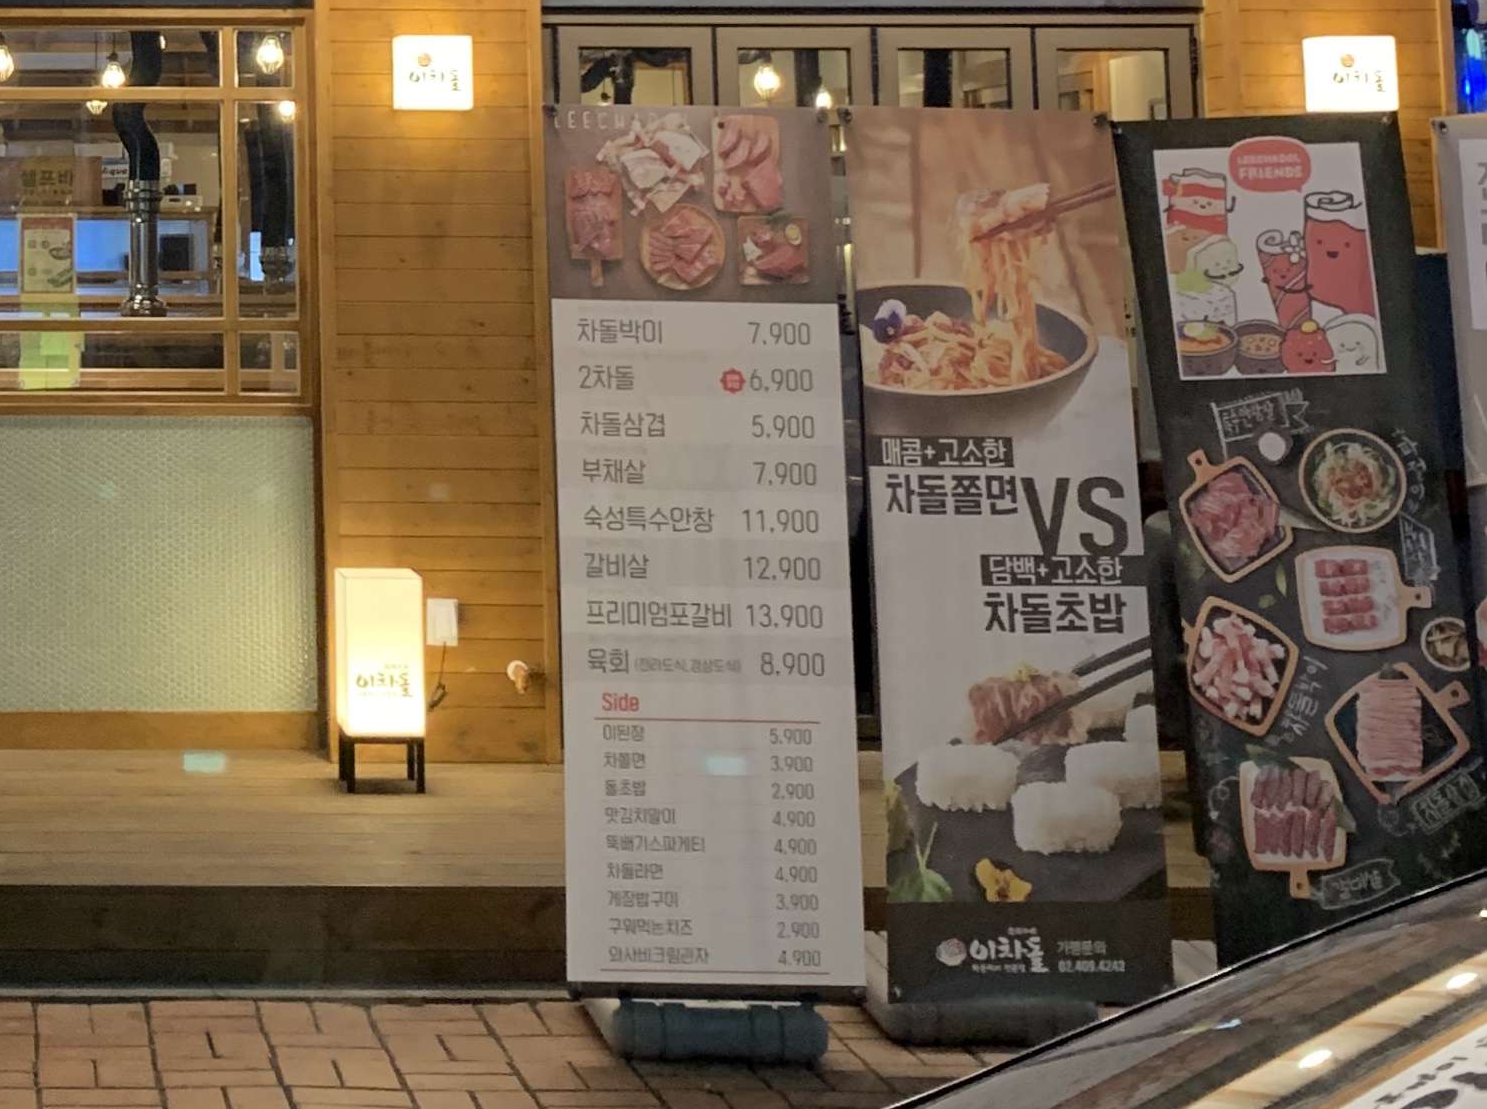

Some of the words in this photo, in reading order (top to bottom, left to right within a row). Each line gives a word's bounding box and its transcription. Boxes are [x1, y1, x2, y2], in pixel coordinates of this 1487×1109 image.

[1238, 165, 1304, 180] FRIENDS
[577, 318, 664, 344] 차돌박이
[578, 365, 635, 391] 2차돌
[580, 411, 666, 438] 차돌삼겹
[881, 437, 1006, 467] 매콤+고소한
[582, 458, 647, 485] 부채살
[885, 473, 1018, 515] 차돌쫄면
[583, 505, 715, 534] 숙성특수안창
[1020, 476, 1129, 558] VS
[584, 552, 650, 580] 갈비살
[989, 556, 1123, 585] 담백+고소한
[586, 600, 732, 629] 프리미엄포갈비
[983, 592, 1127, 634] 차돌초밥
[588, 648, 630, 674] 육회
[601, 692, 640, 712] Side
[602, 724, 645, 742] 이된장
[606, 834, 706, 853] 뚝배기스파게티
[607, 862, 663, 880] 차돌라면
[969, 936, 1050, 973] 이차돌
